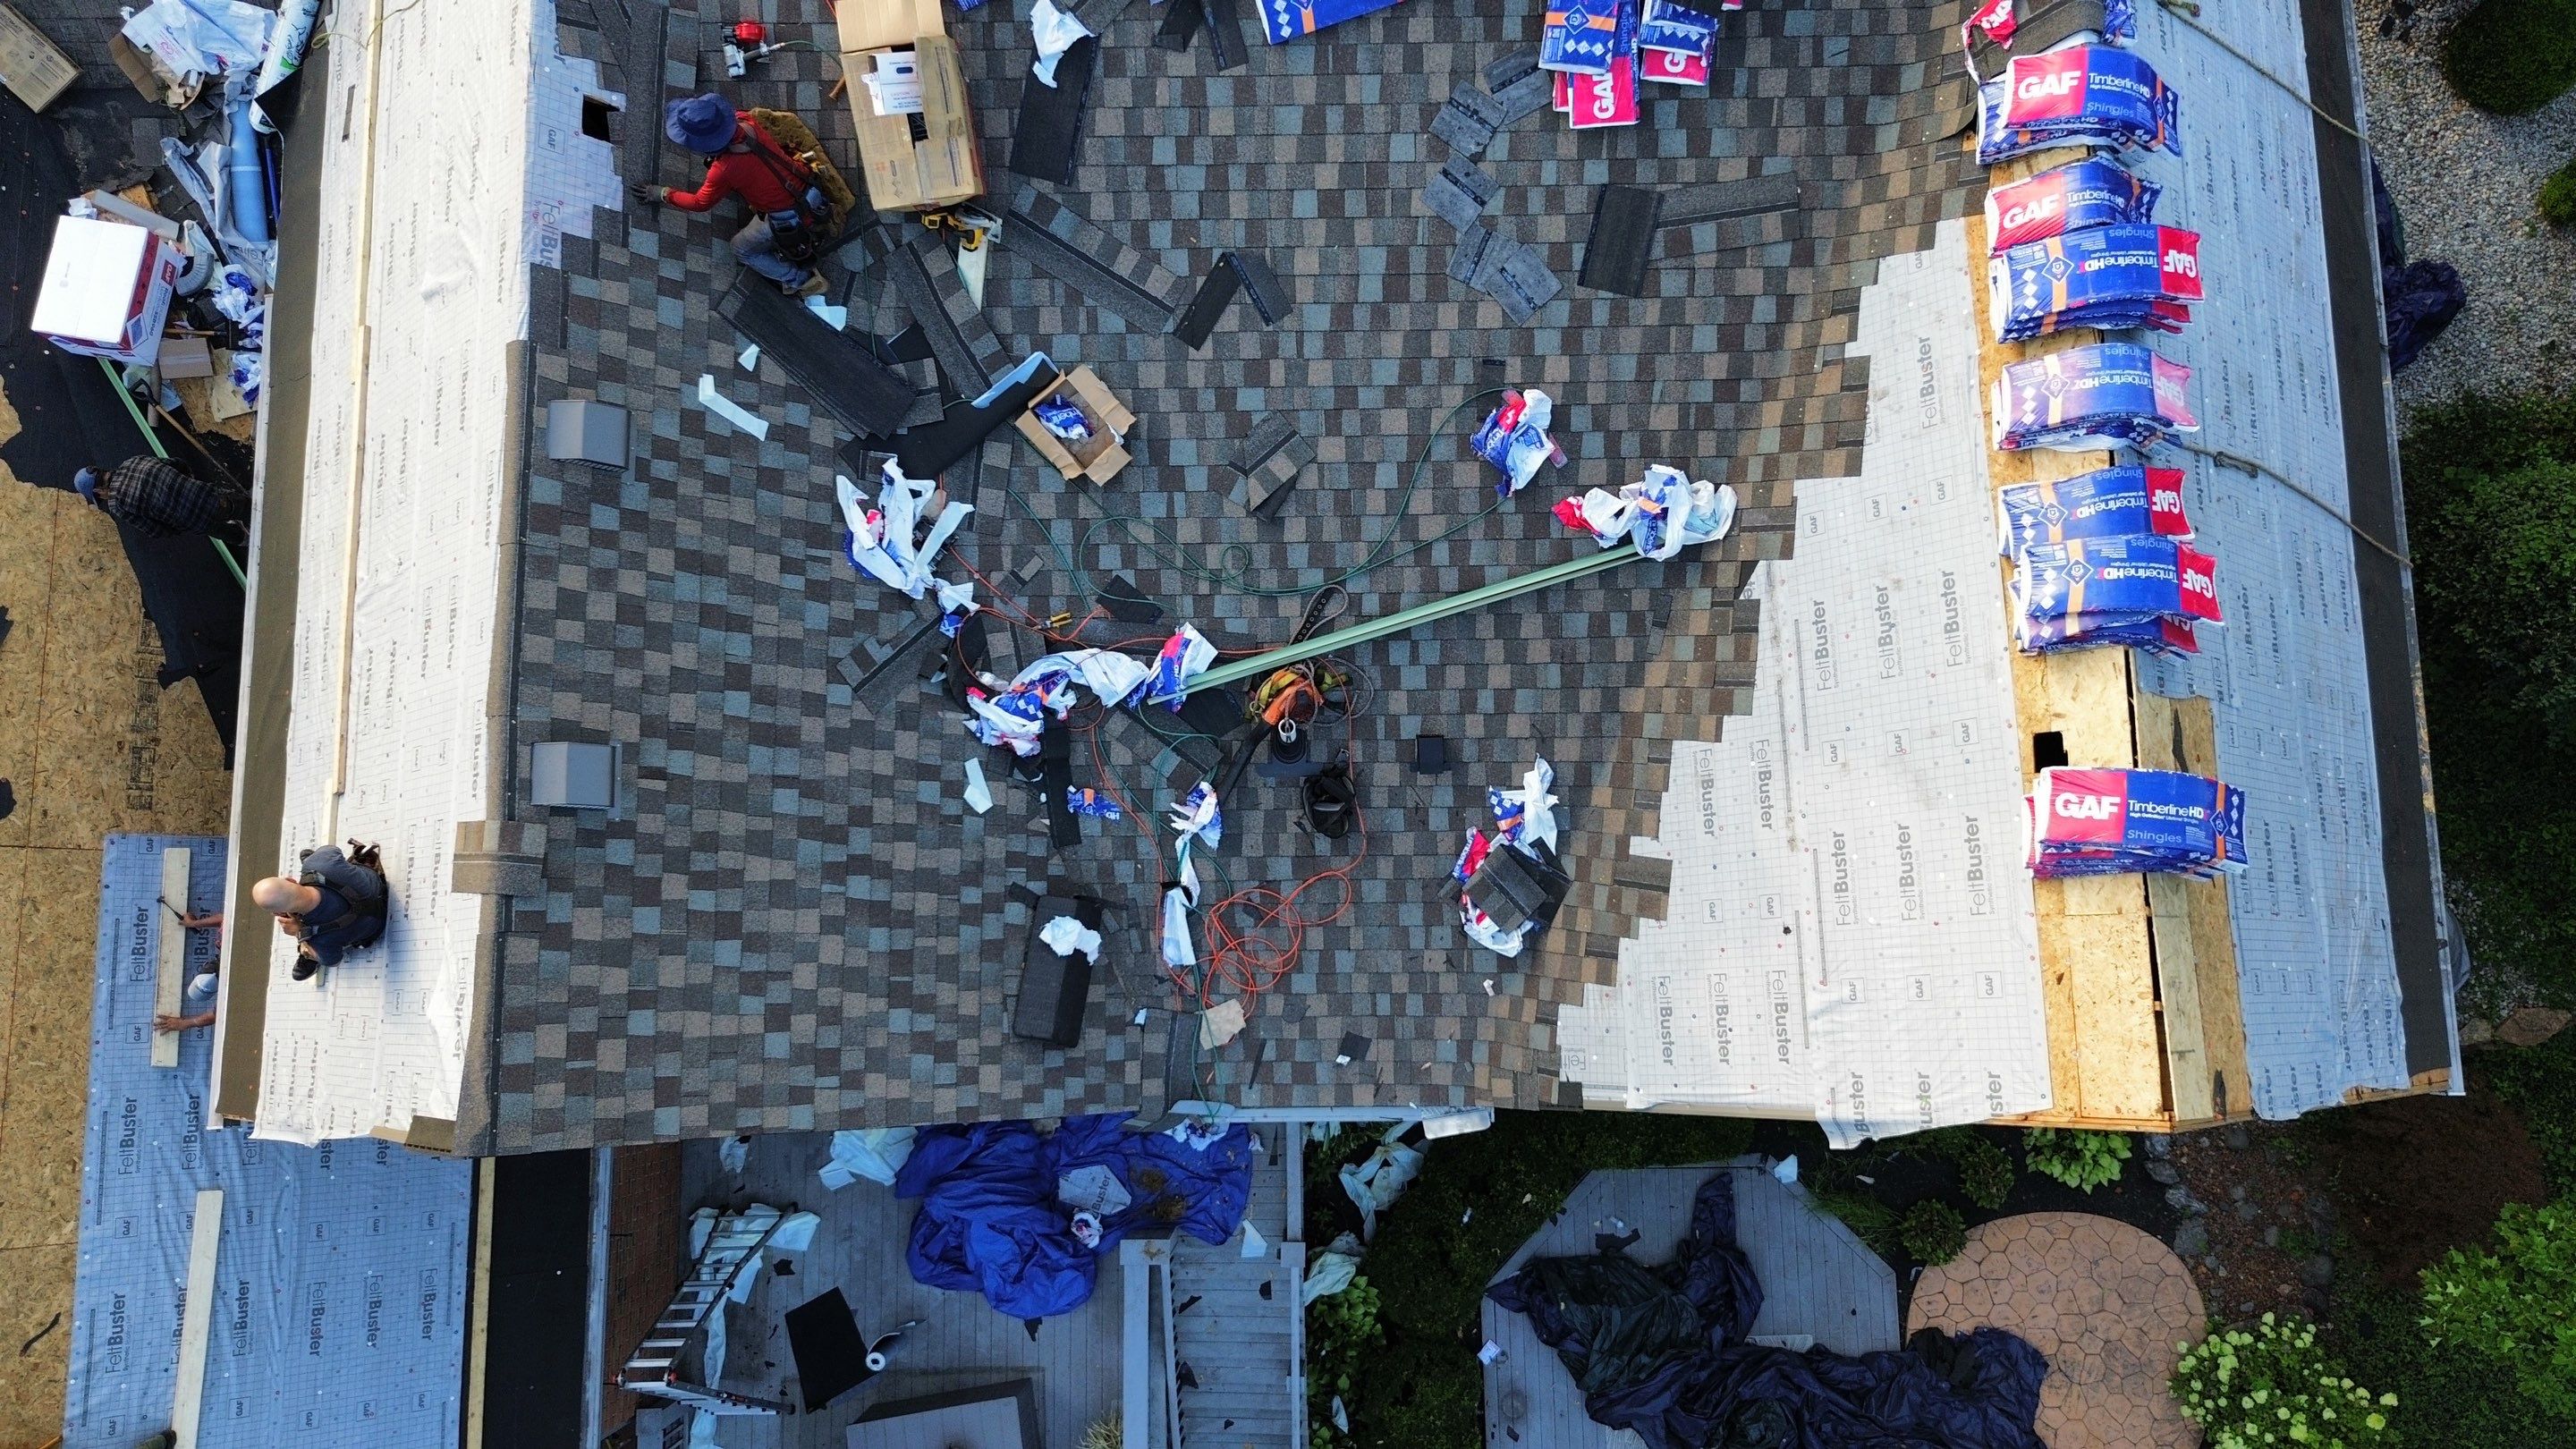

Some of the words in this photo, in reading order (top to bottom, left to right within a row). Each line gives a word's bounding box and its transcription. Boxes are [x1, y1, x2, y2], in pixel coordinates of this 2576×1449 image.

[2018, 71, 2081, 100] GAF
[2087, 102, 2134, 117] Shingles
[547, 129, 555, 152] GAF
[2003, 194, 2061, 229] GAF
[2108, 227, 2156, 240] Shingles
[496, 208, 509, 304] FeltBuster
[2163, 249, 2198, 278] GAF
[459, 339, 471, 433] FeltBuster
[1917, 336, 1937, 429] FeltBuster
[2156, 376, 2185, 406] GAF
[1936, 480, 1946, 501] GAF
[2095, 468, 2144, 481] Shingles
[1872, 498, 1881, 518] GAF
[2151, 489, 2181, 514] GAF
[1809, 514, 1818, 534] GAF
[2131, 539, 2175, 552] Shingles
[2182, 568, 2213, 599] GAF
[420, 586, 433, 680] FeltBuster
[447, 574, 459, 669] FeltBuster
[1875, 586, 1896, 680] FeltBuster
[1940, 571, 1963, 667] FeltBuster
[2243, 584, 2257, 676] FeltBuster
[1812, 600, 1832, 691] FeltBuster
[1894, 733, 1903, 753] GAF
[1961, 722, 1970, 742] GAF
[471, 699, 483, 801] FeltBuster
[1830, 743, 1838, 763] GAF
[1699, 748, 1717, 837] FeltBuster
[1756, 739, 1775, 830] FeltBuster
[2055, 792, 2121, 821] GAF
[146, 837, 155, 852] GAF
[208, 839, 216, 855] GAF
[2127, 829, 2182, 844] Shingles
[404, 824, 416, 920] FeltBuster
[430, 818, 443, 918] FeltBuster
[1831, 831, 1852, 926] FeltBuster
[1895, 823, 1918, 921] FeltBuster
[1963, 816, 1987, 916] FeltBuster
[2263, 815, 2279, 916] FeltBuster
[2289, 823, 2306, 917] FeltBuster
[1708, 902, 1716, 920] GAF
[1766, 896, 1775, 916] GAF
[130, 905, 149, 982] FeltBuster
[1849, 980, 1857, 1002] GAF
[1915, 978, 1924, 998] GAF
[1985, 974, 1994, 996] GAF
[1657, 975, 1675, 1066] FeltBuster
[1713, 972, 1733, 1065] FeltBuster
[1772, 970, 1792, 1064] FeltBuster
[2380, 979, 2396, 1066] FeltBuster
[117, 1097, 138, 1175] FeltBuster
[182, 1093, 200, 1171] FeltBuster
[320, 1140, 335, 1171] ster
[123, 1219, 131, 1235] GAF
[186, 1213, 194, 1230] GAF
[246, 1208, 254, 1224] GAF
[233, 1279, 250, 1358] FeltBuster
[309, 1281, 326, 1358] FeltBuster
[366, 1275, 384, 1350] FeltBuster
[421, 1267, 438, 1341] FeltBuster
[105, 1292, 126, 1374] FeltBuster
[418, 1394, 426, 1409] GAF
[108, 1419, 116, 1436] GAF
[305, 1411, 313, 1428] GAF
